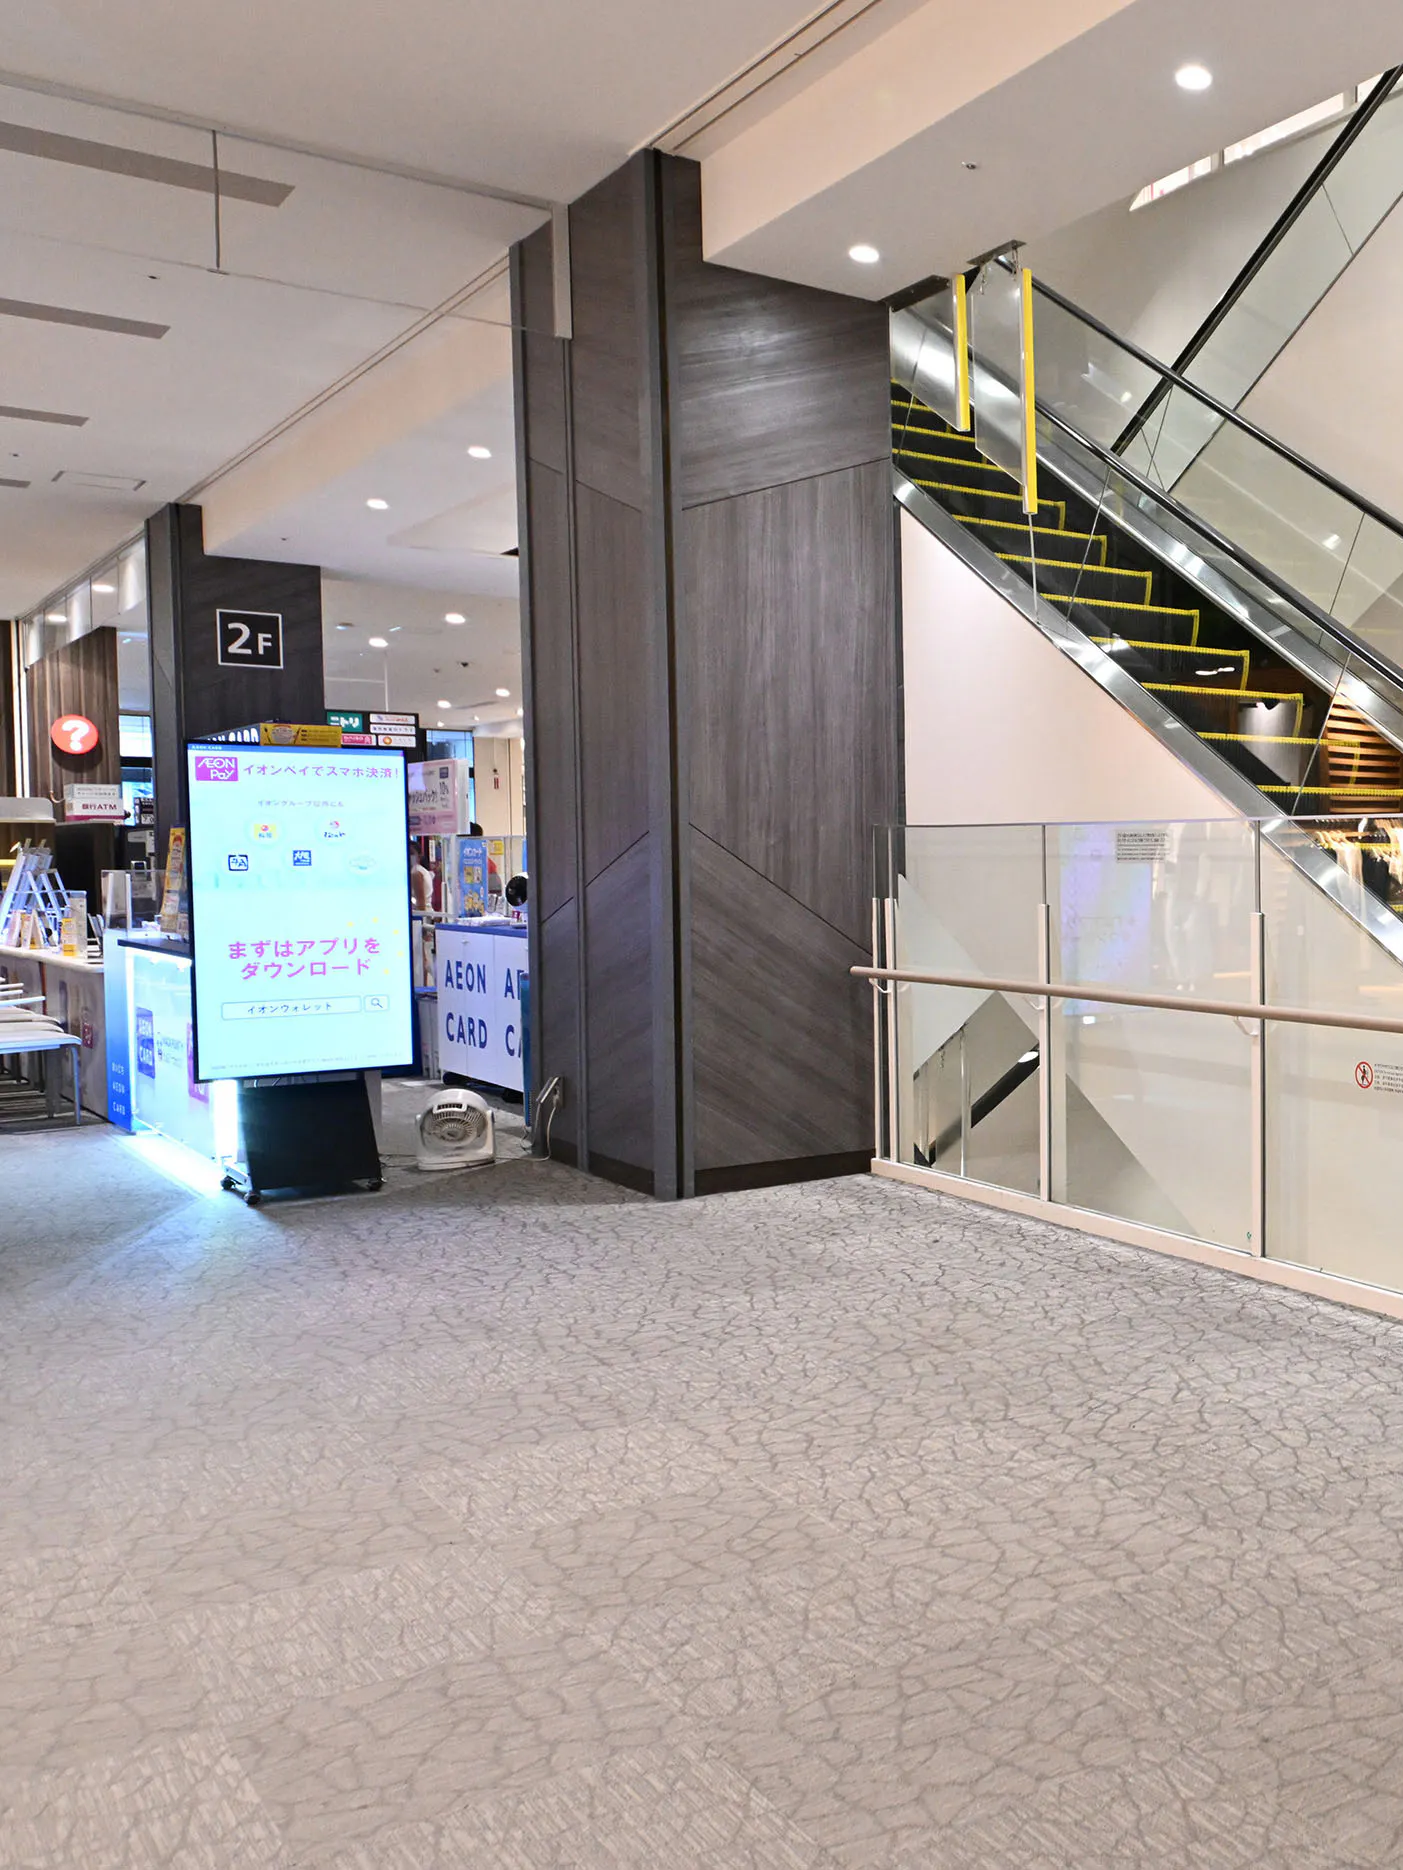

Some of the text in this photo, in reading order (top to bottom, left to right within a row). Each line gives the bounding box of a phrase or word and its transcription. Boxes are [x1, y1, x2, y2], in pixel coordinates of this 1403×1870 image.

[227, 622, 273, 655] 2F
[228, 937, 380, 959] まずはアプリを
[241, 958, 371, 980] ダウンロード
[445, 960, 486, 993] AEON
[247, 1002, 332, 1015] イオンウォレット
[446, 1012, 488, 1049] CARD
